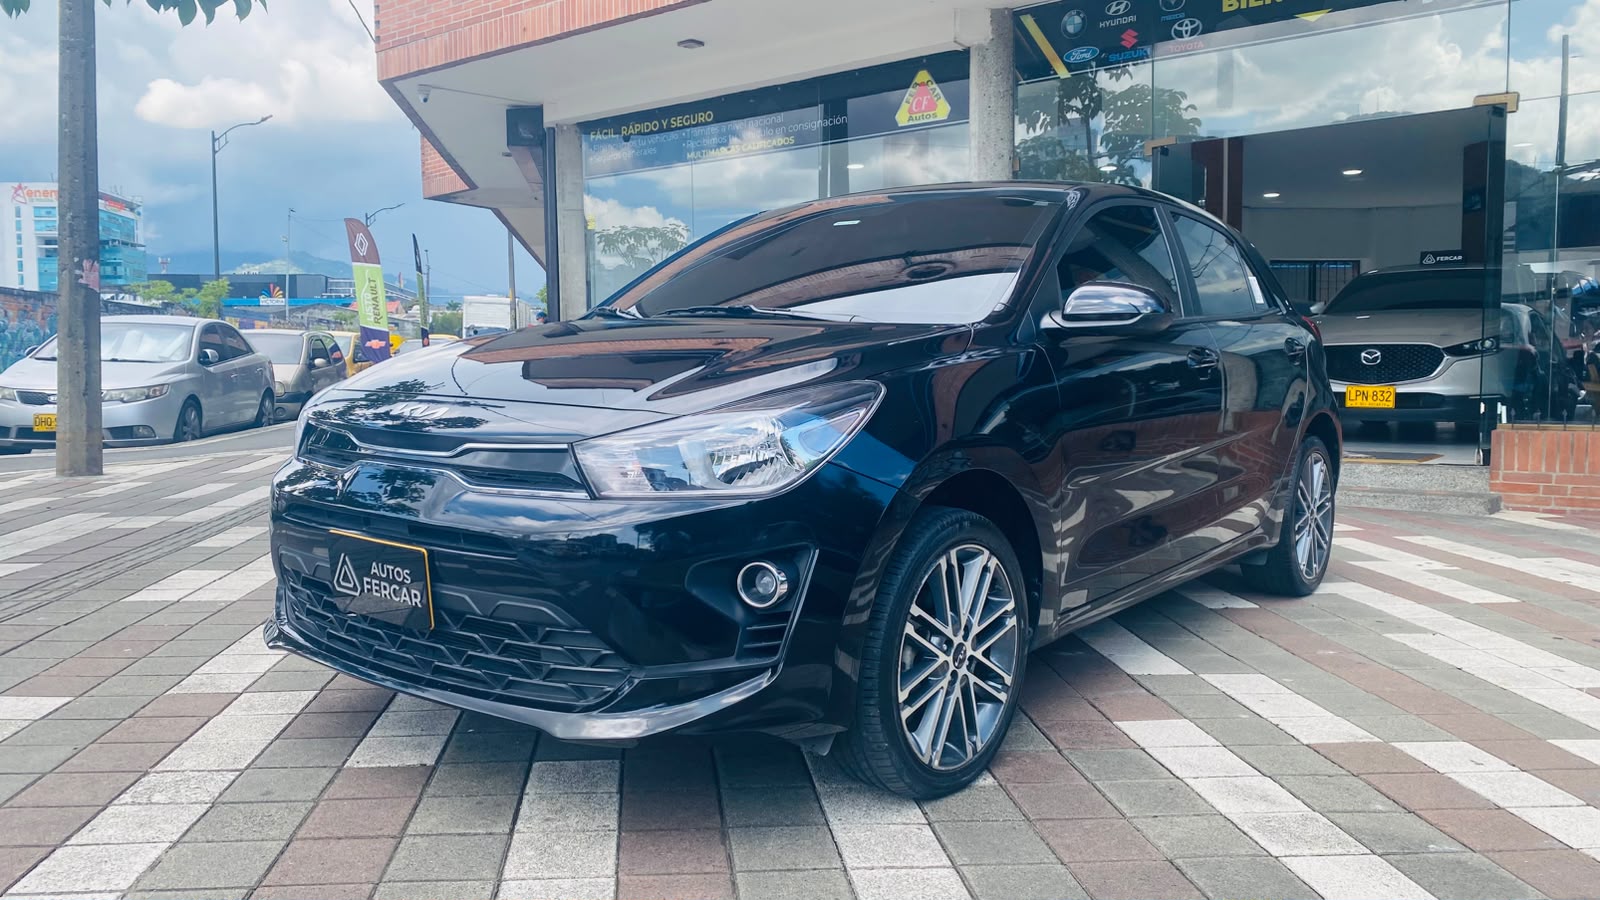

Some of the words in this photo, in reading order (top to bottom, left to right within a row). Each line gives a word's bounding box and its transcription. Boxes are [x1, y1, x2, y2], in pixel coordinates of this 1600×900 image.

[1099, 15, 1137, 29] HYUNDAI
[1070, 48, 1093, 61] Ford
[1108, 46, 1152, 62] SUZUKI
[1168, 41, 1205, 53] TOYOTA
[911, 95, 931, 113] CF
[621, 120, 659, 137] RÁPIDO
[661, 118, 669, 130] Y
[670, 110, 714, 129] SEGURO
[748, 113, 784, 129] nacional
[775, 126, 786, 136] en
[788, 115, 848, 133] consignación
[907, 112, 938, 123] Autos
[742, 136, 795, 152] CALIFICADOS
[368, 277, 384, 325] RENAULT
[1348, 389, 1369, 402] LPN
[1371, 390, 1393, 403] 832
[370, 561, 411, 584] AUTOS
[363, 576, 422, 608] FERCAR
